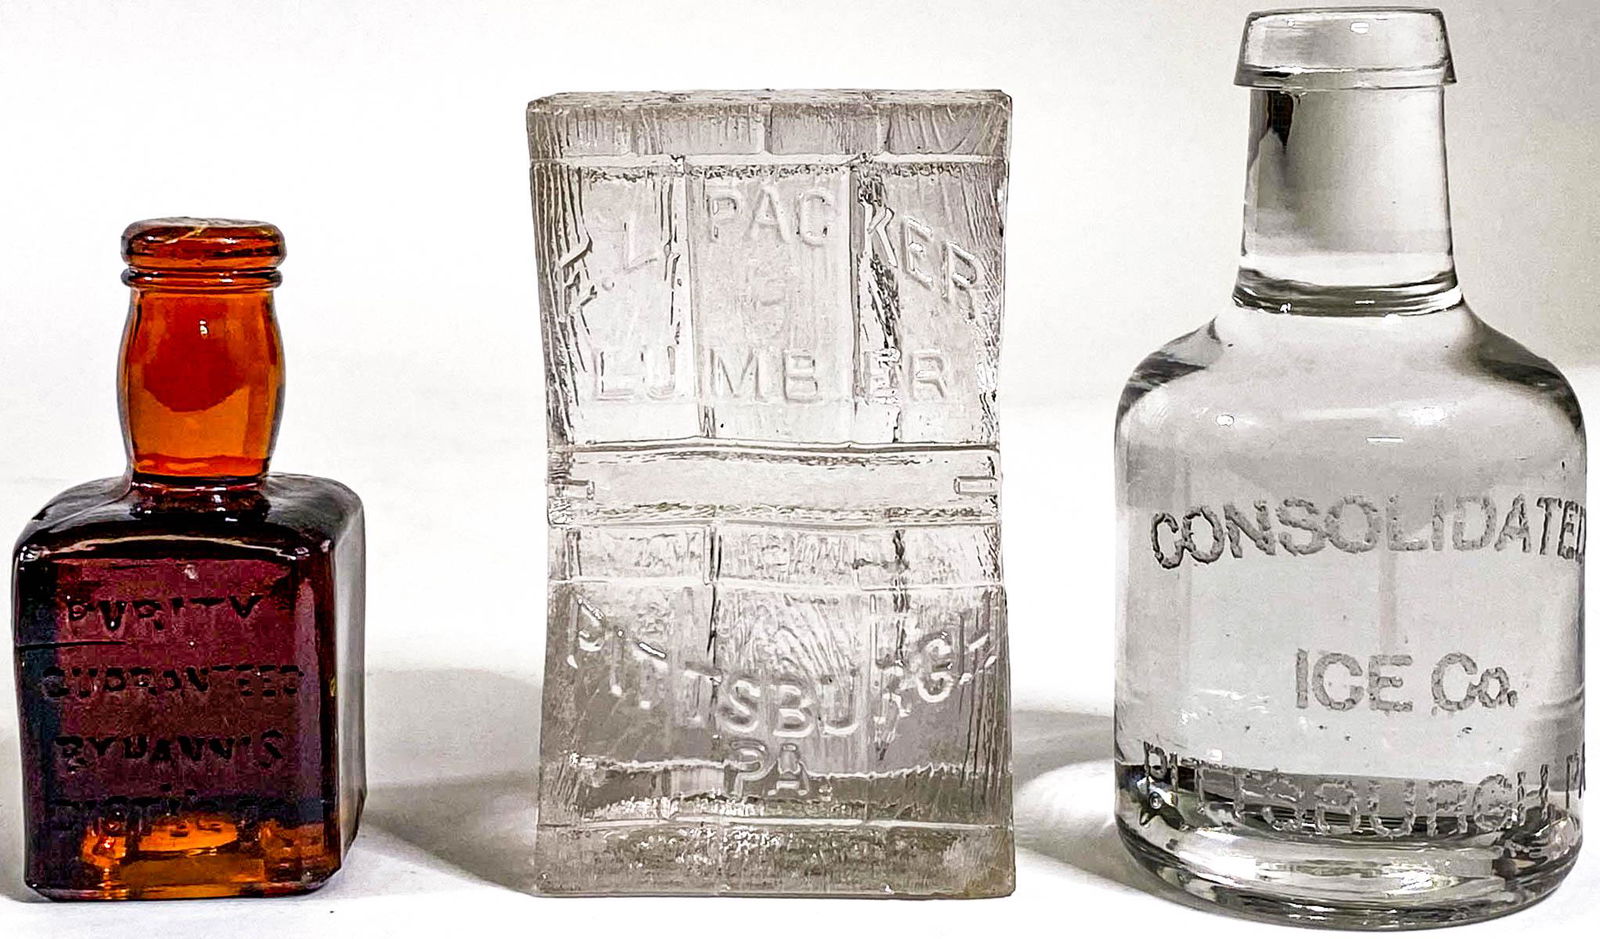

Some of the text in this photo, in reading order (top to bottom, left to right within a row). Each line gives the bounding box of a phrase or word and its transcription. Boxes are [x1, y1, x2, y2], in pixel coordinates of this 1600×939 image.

[706, 184, 978, 319] PACKER
[591, 348, 946, 402] LUMBER
[1297, 650, 1413, 711] ICE
